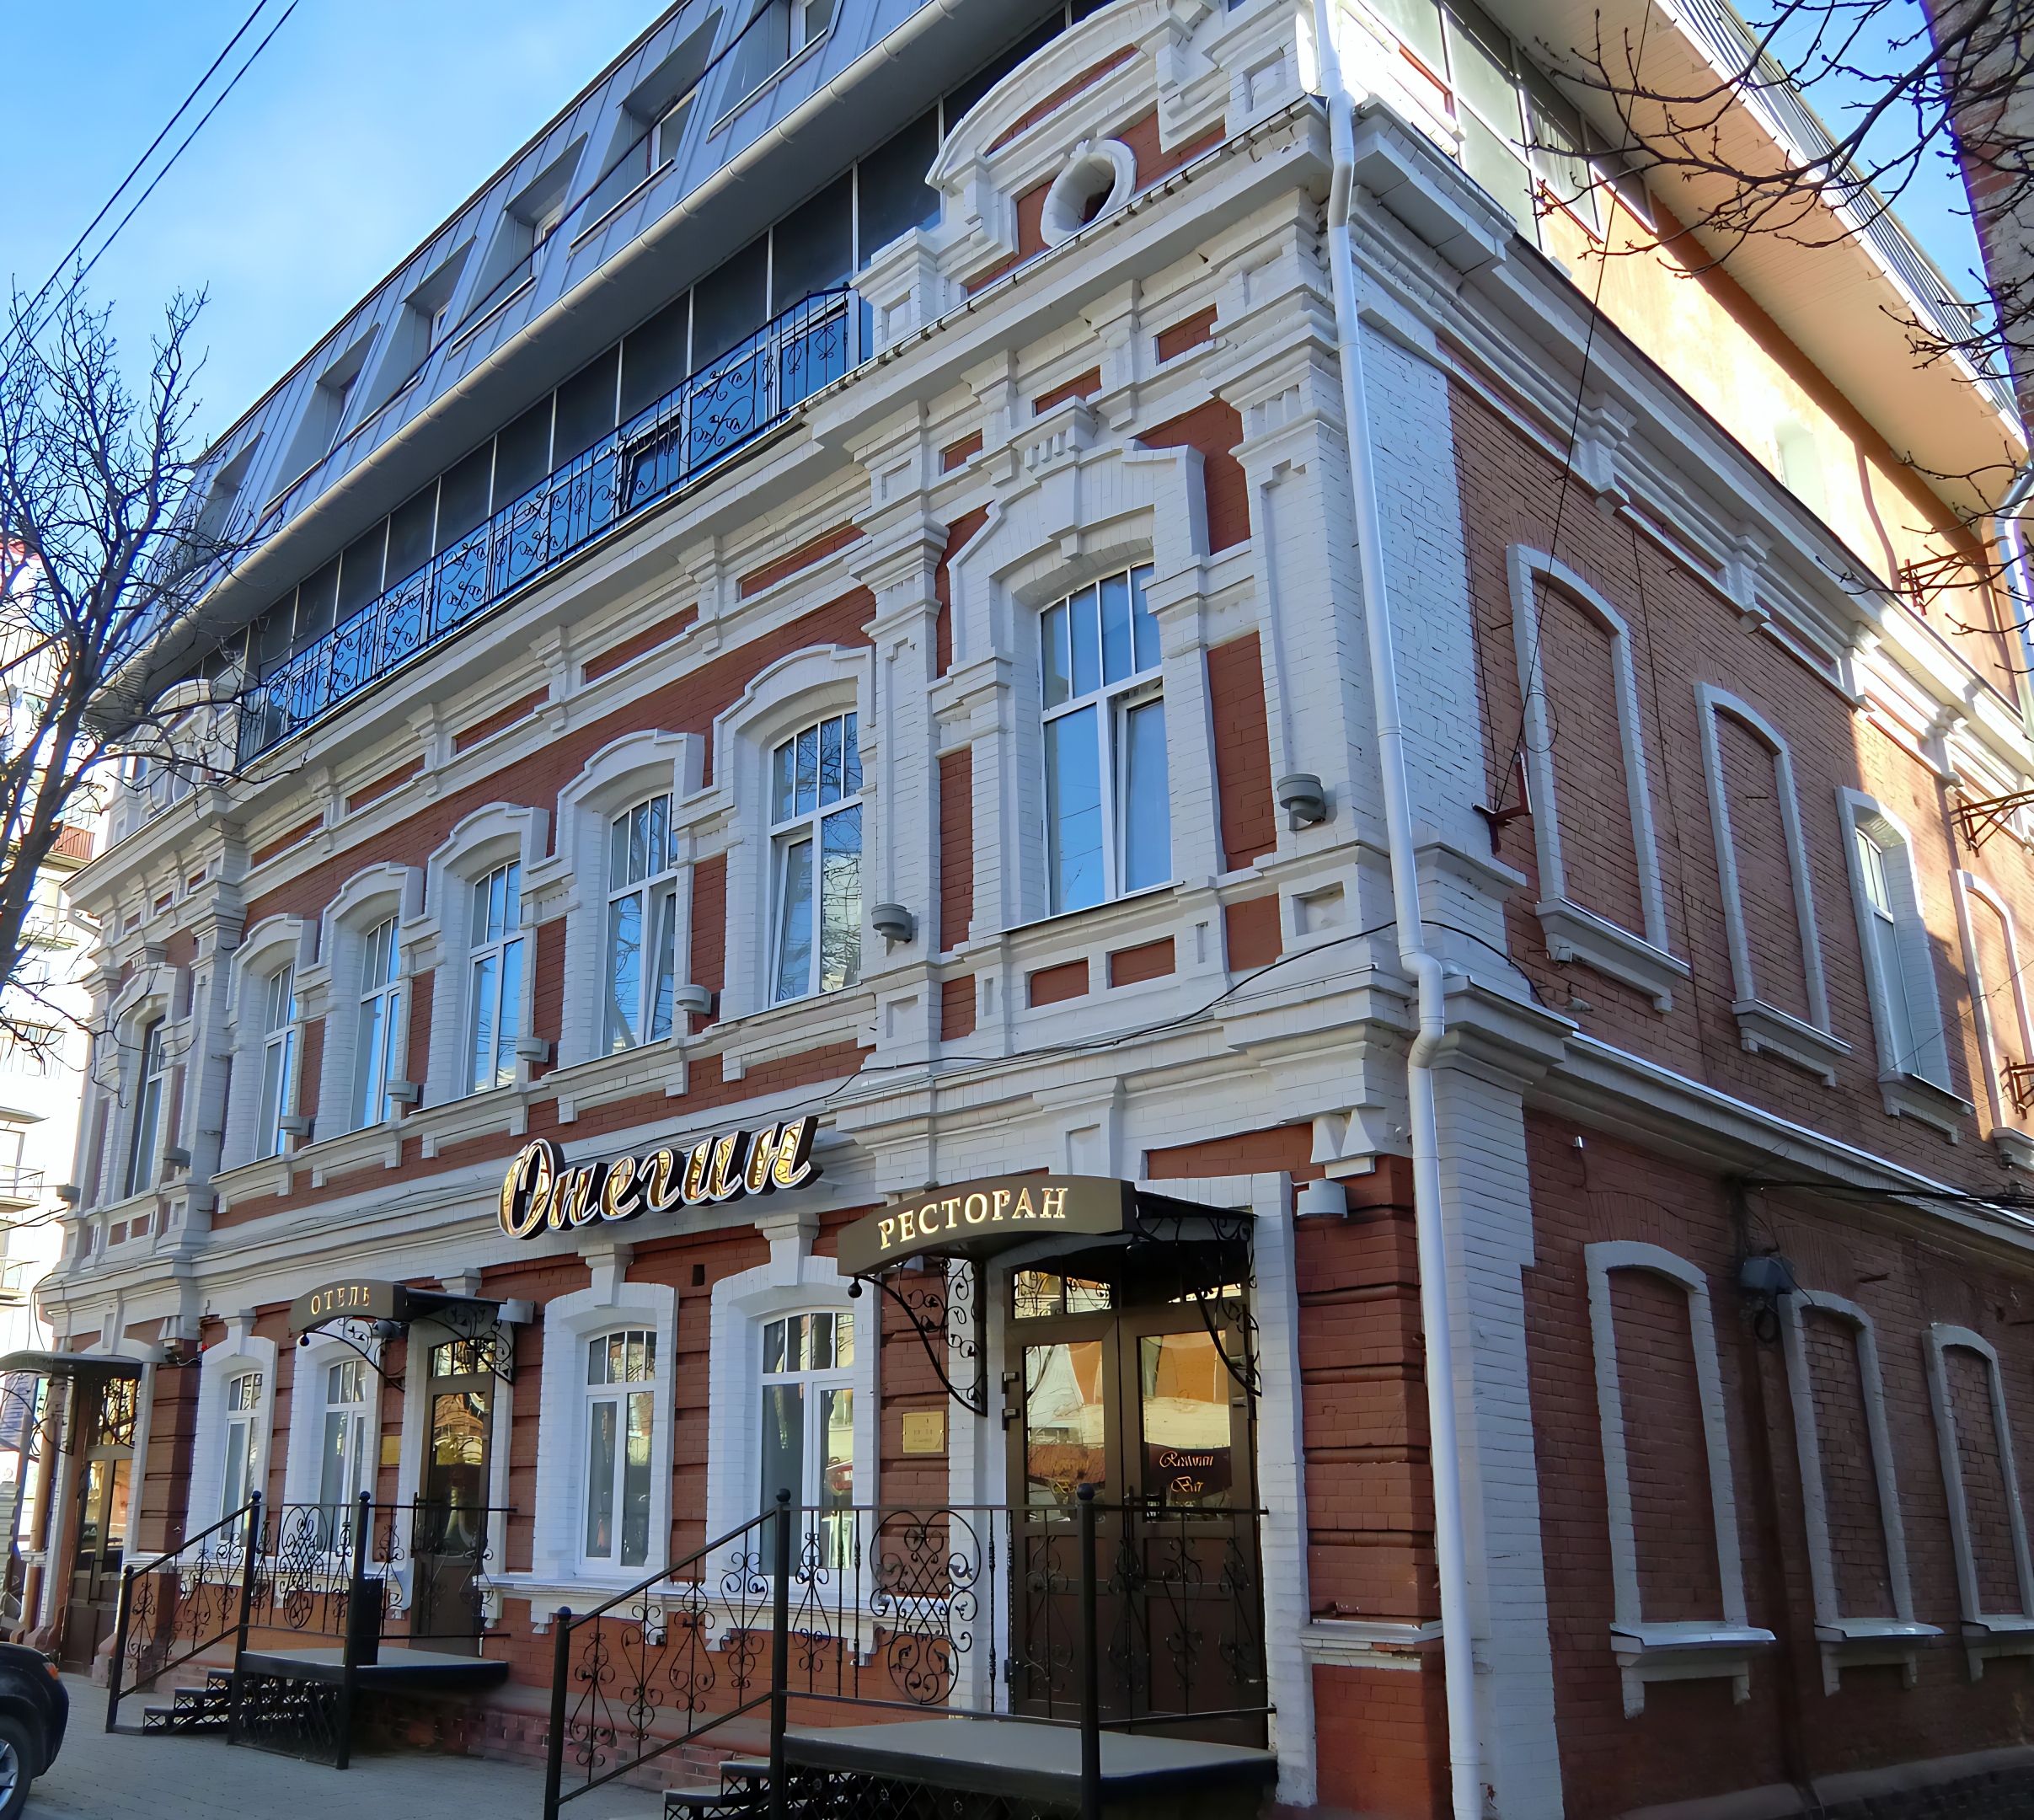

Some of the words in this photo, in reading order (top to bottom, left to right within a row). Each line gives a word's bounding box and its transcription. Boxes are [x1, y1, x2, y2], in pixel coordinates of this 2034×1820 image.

[497, 1116, 817, 1239] Онегин
[877, 1186, 1068, 1250] РЕСТОРАН
[311, 1286, 370, 1315] ОТЕЛЬ
